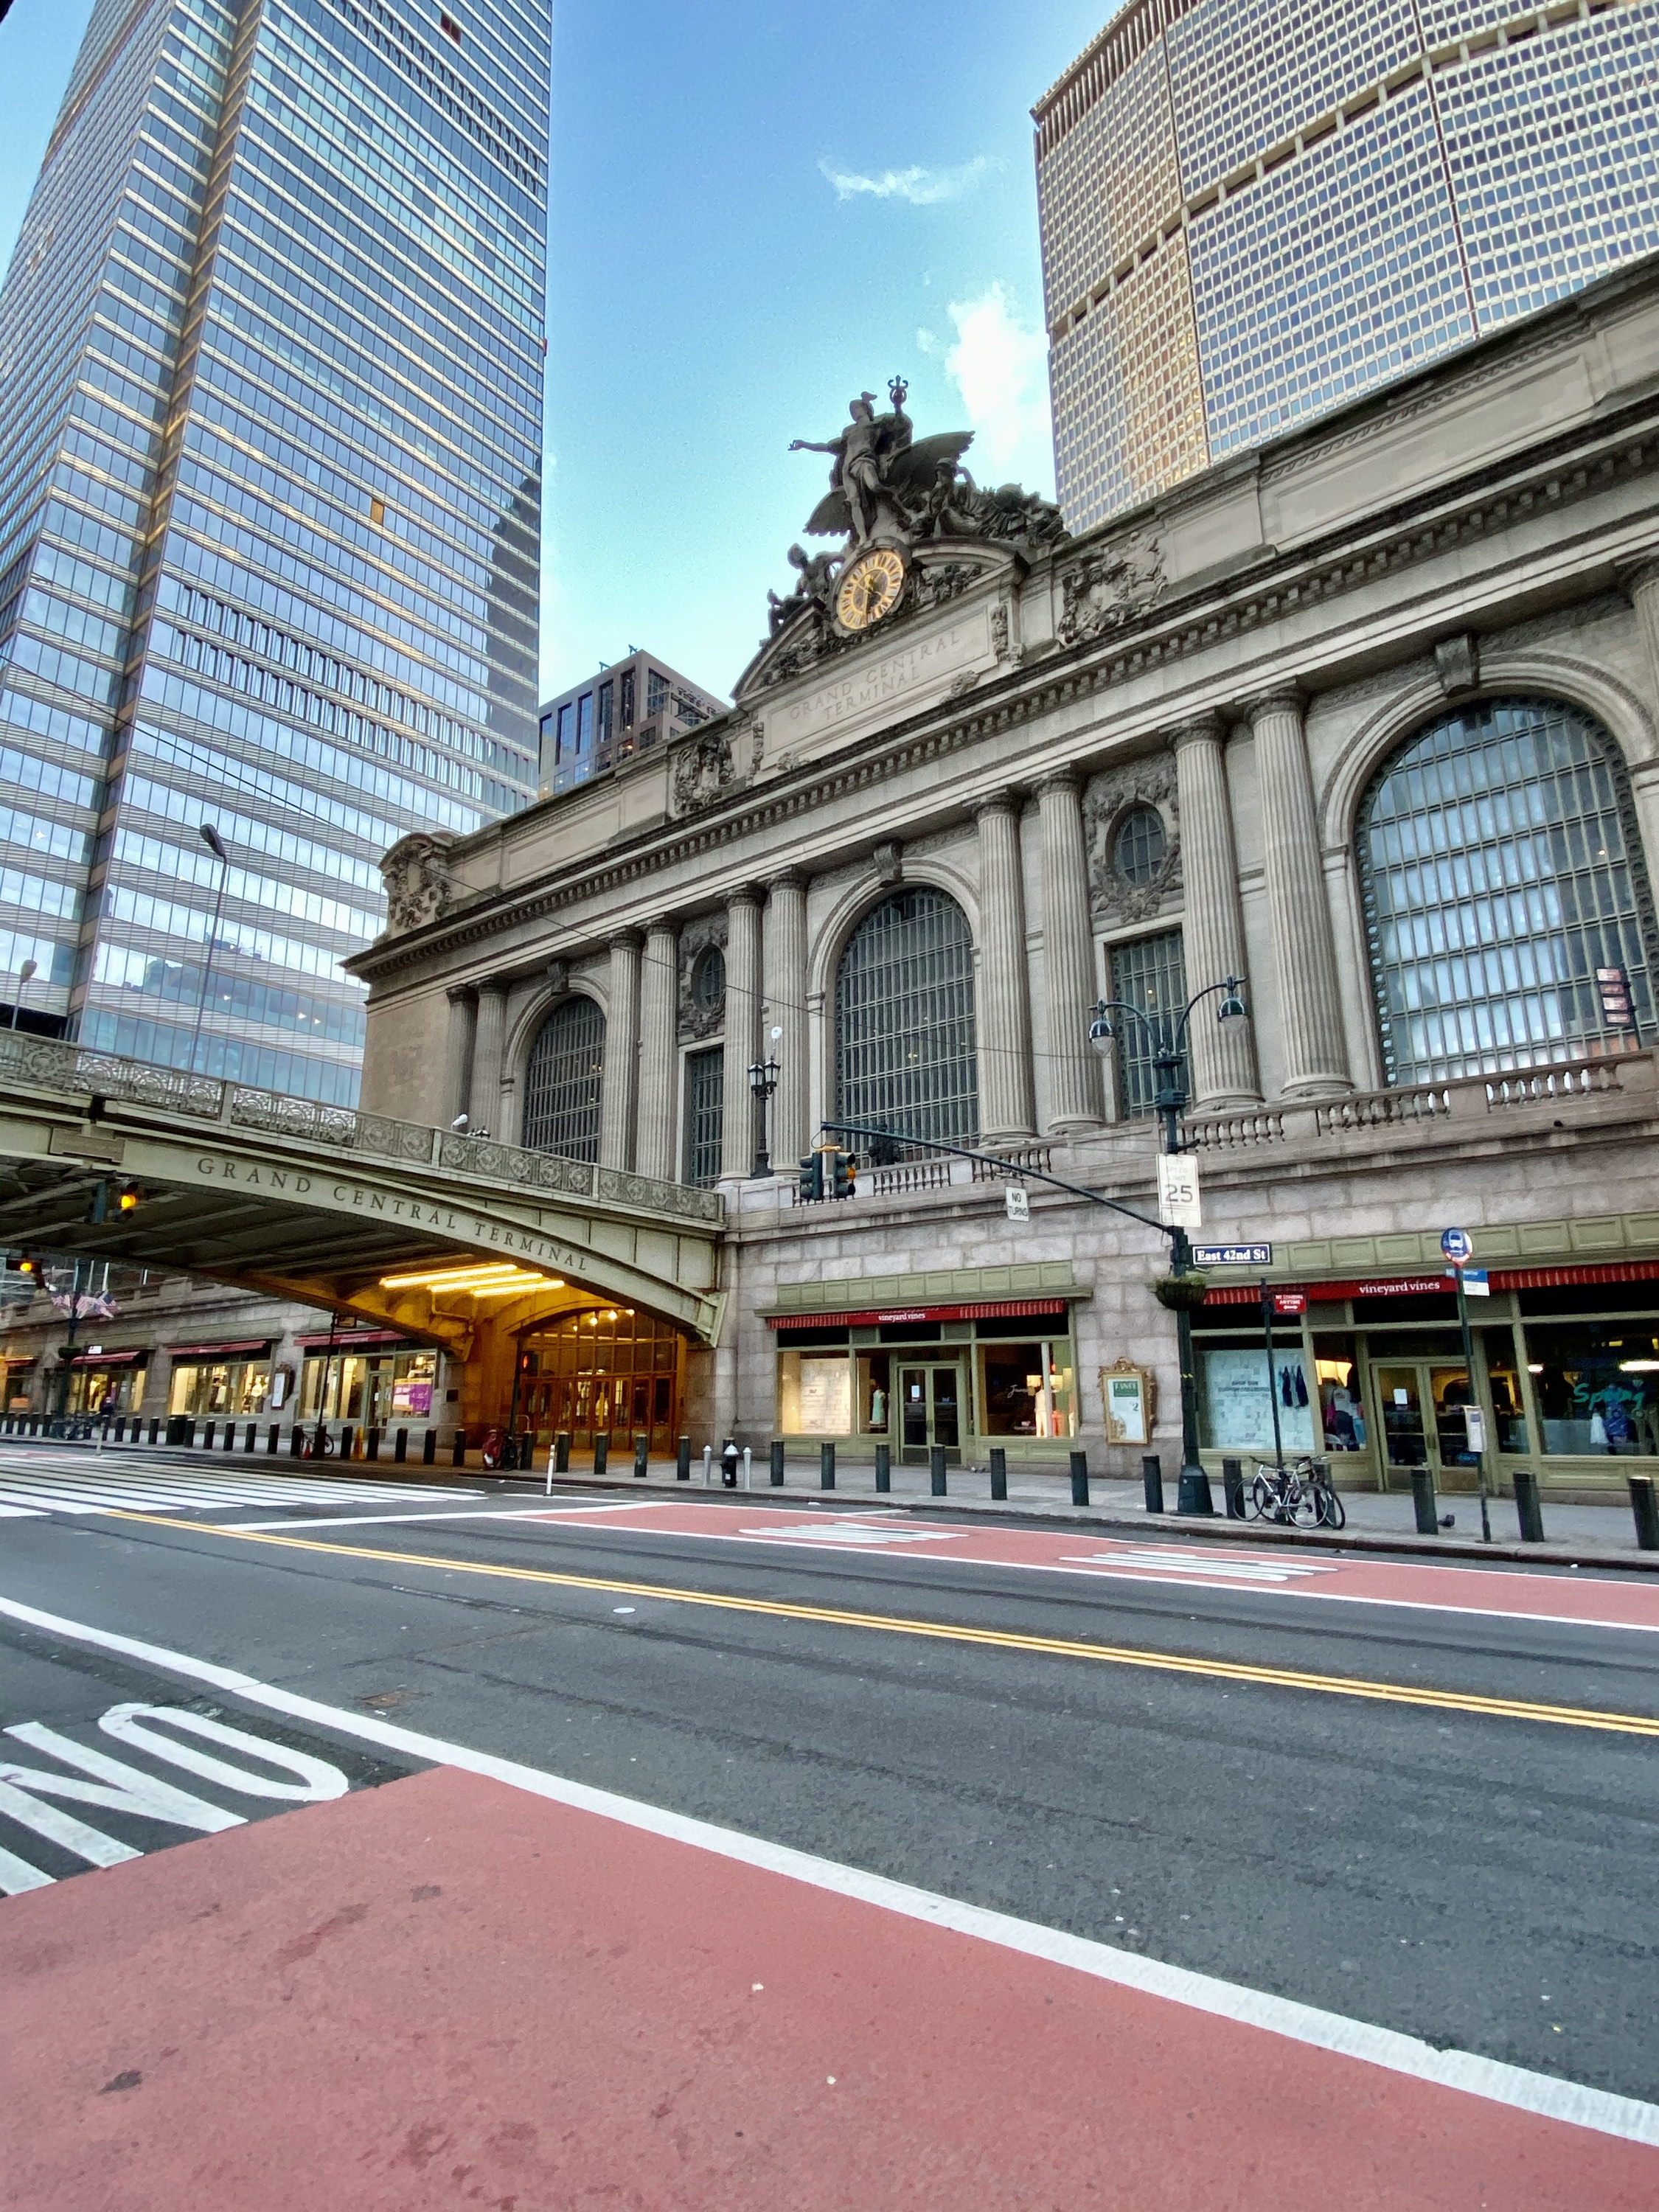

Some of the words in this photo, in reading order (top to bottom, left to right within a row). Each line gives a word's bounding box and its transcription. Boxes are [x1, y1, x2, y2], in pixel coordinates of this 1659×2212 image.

[790, 684, 852, 720] GRAND
[866, 630, 960, 684] CENTRAL
[824, 666, 921, 720] TERMINAL
[1012, 1192, 1022, 1203] NO
[1164, 1183, 1193, 1203] 25
[198, 1158, 311, 1193] GRAND
[333, 1185, 456, 1230] CENTRAL
[474, 1221, 587, 1271] TERMINAL
[1008, 1206, 1029, 1217] TURNS
[1197, 1250, 1222, 1262] East
[1222, 1249, 1251, 1261] 42nd
[1253, 1249, 1266, 1260] St
[1359, 1281, 1408, 1295] vineyard
[1409, 1281, 1441, 1292] vines
[878, 1313, 907, 1322] vineyard
